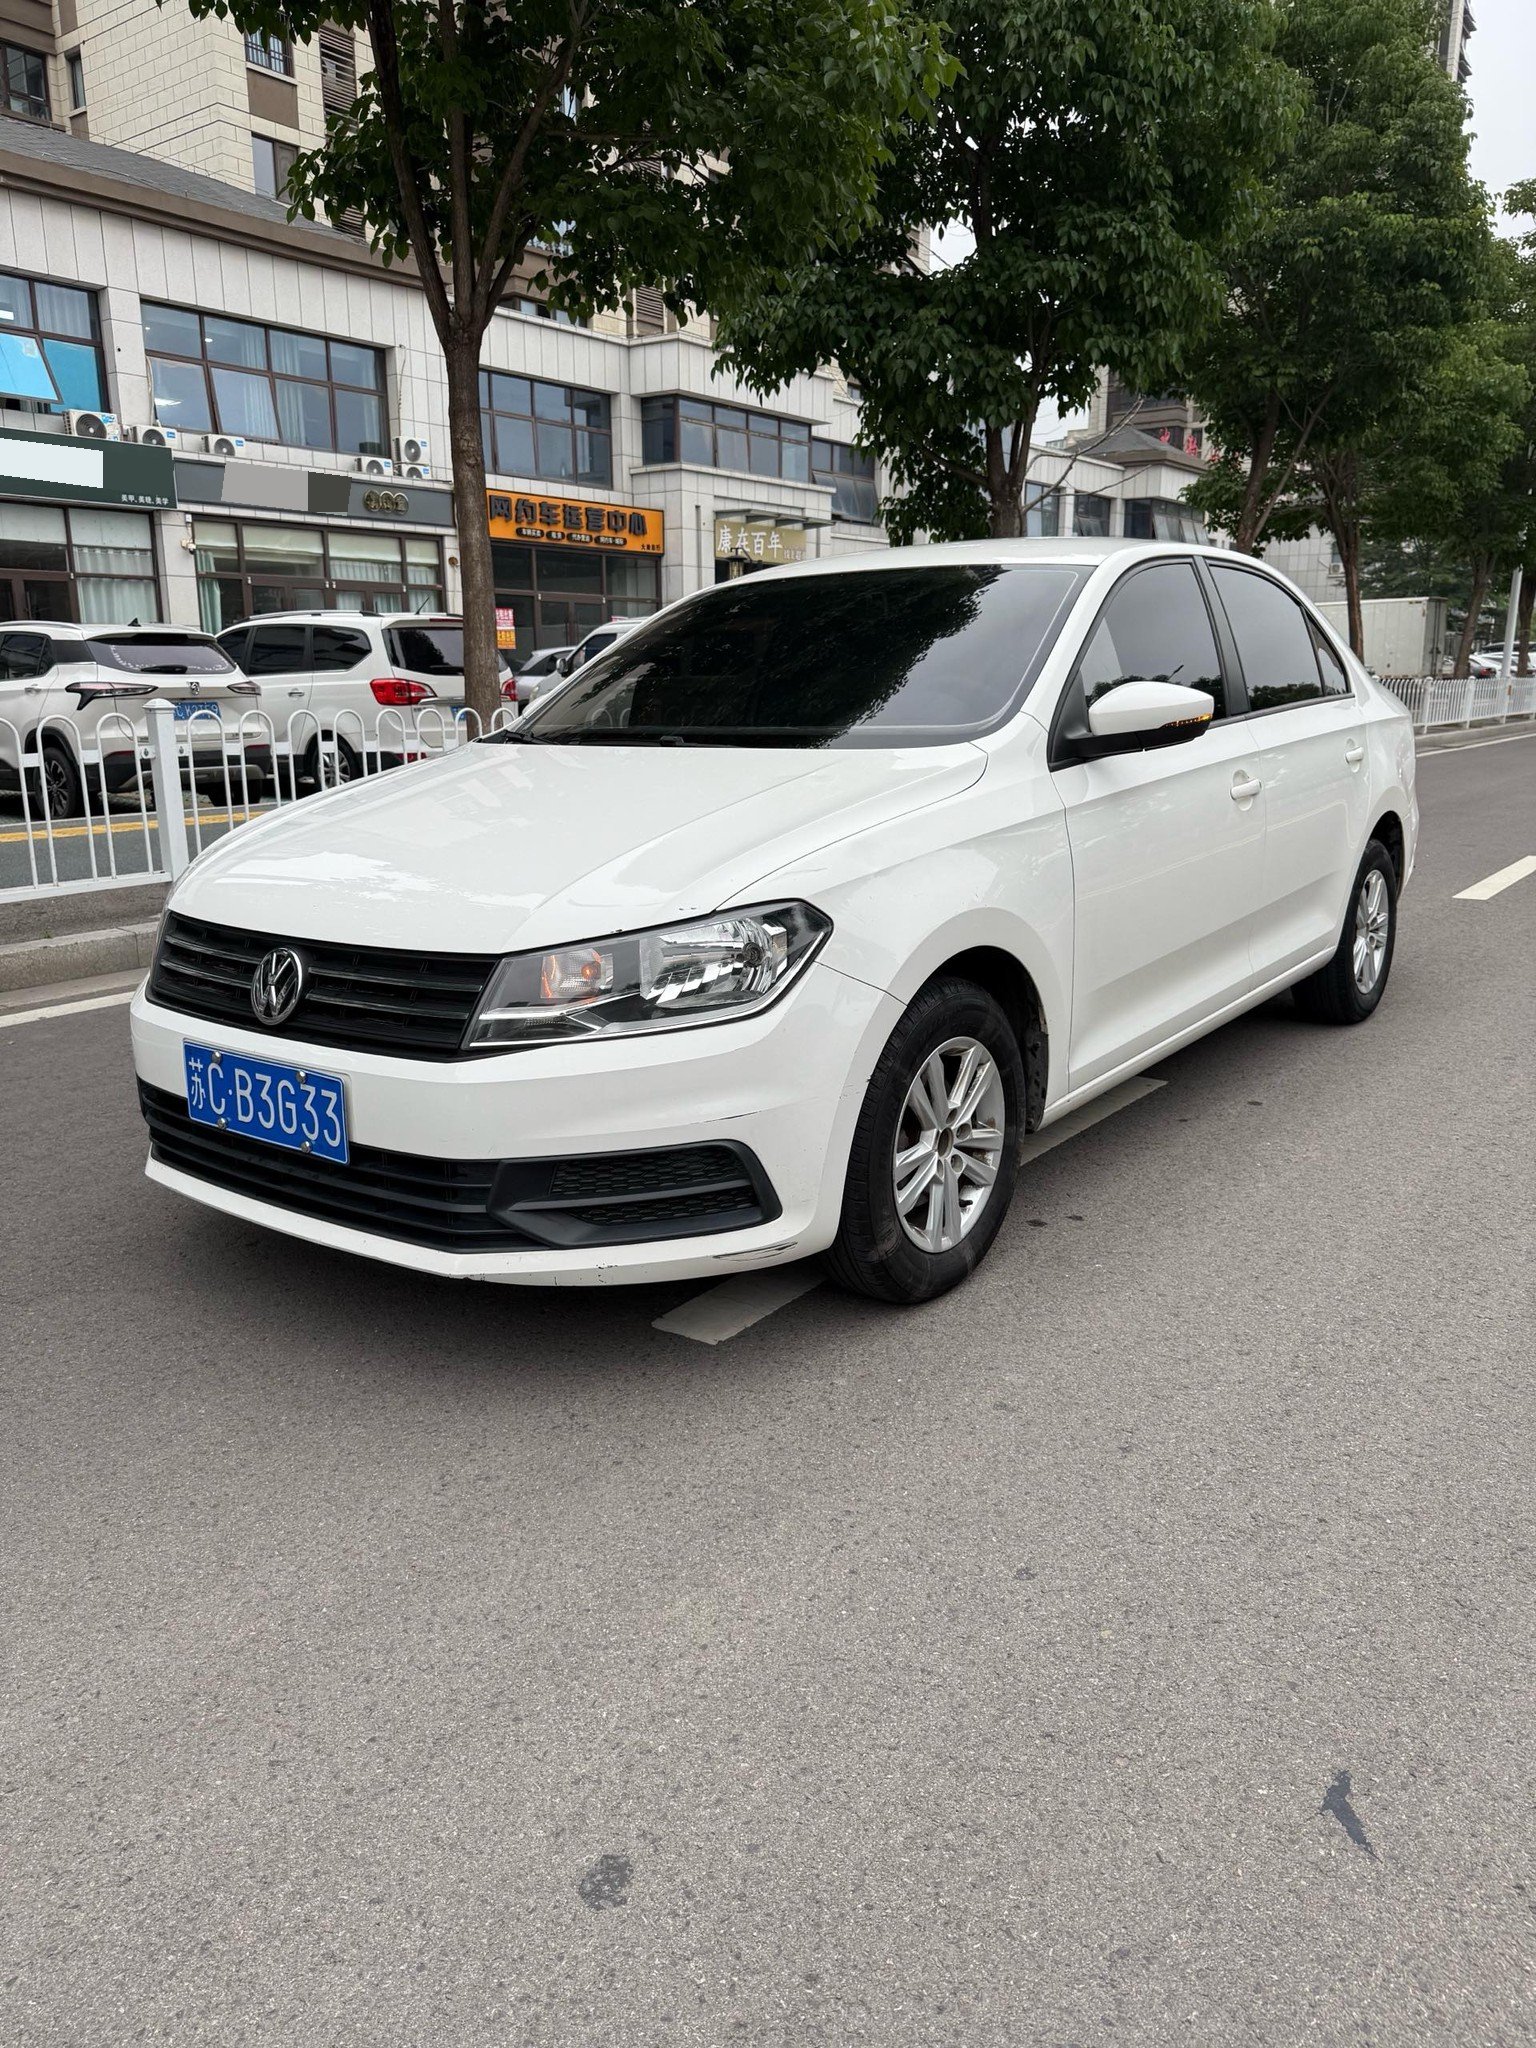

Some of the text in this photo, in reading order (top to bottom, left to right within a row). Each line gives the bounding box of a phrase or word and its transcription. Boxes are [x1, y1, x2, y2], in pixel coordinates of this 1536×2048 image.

[489, 494, 648, 536] 网约车运营中心
